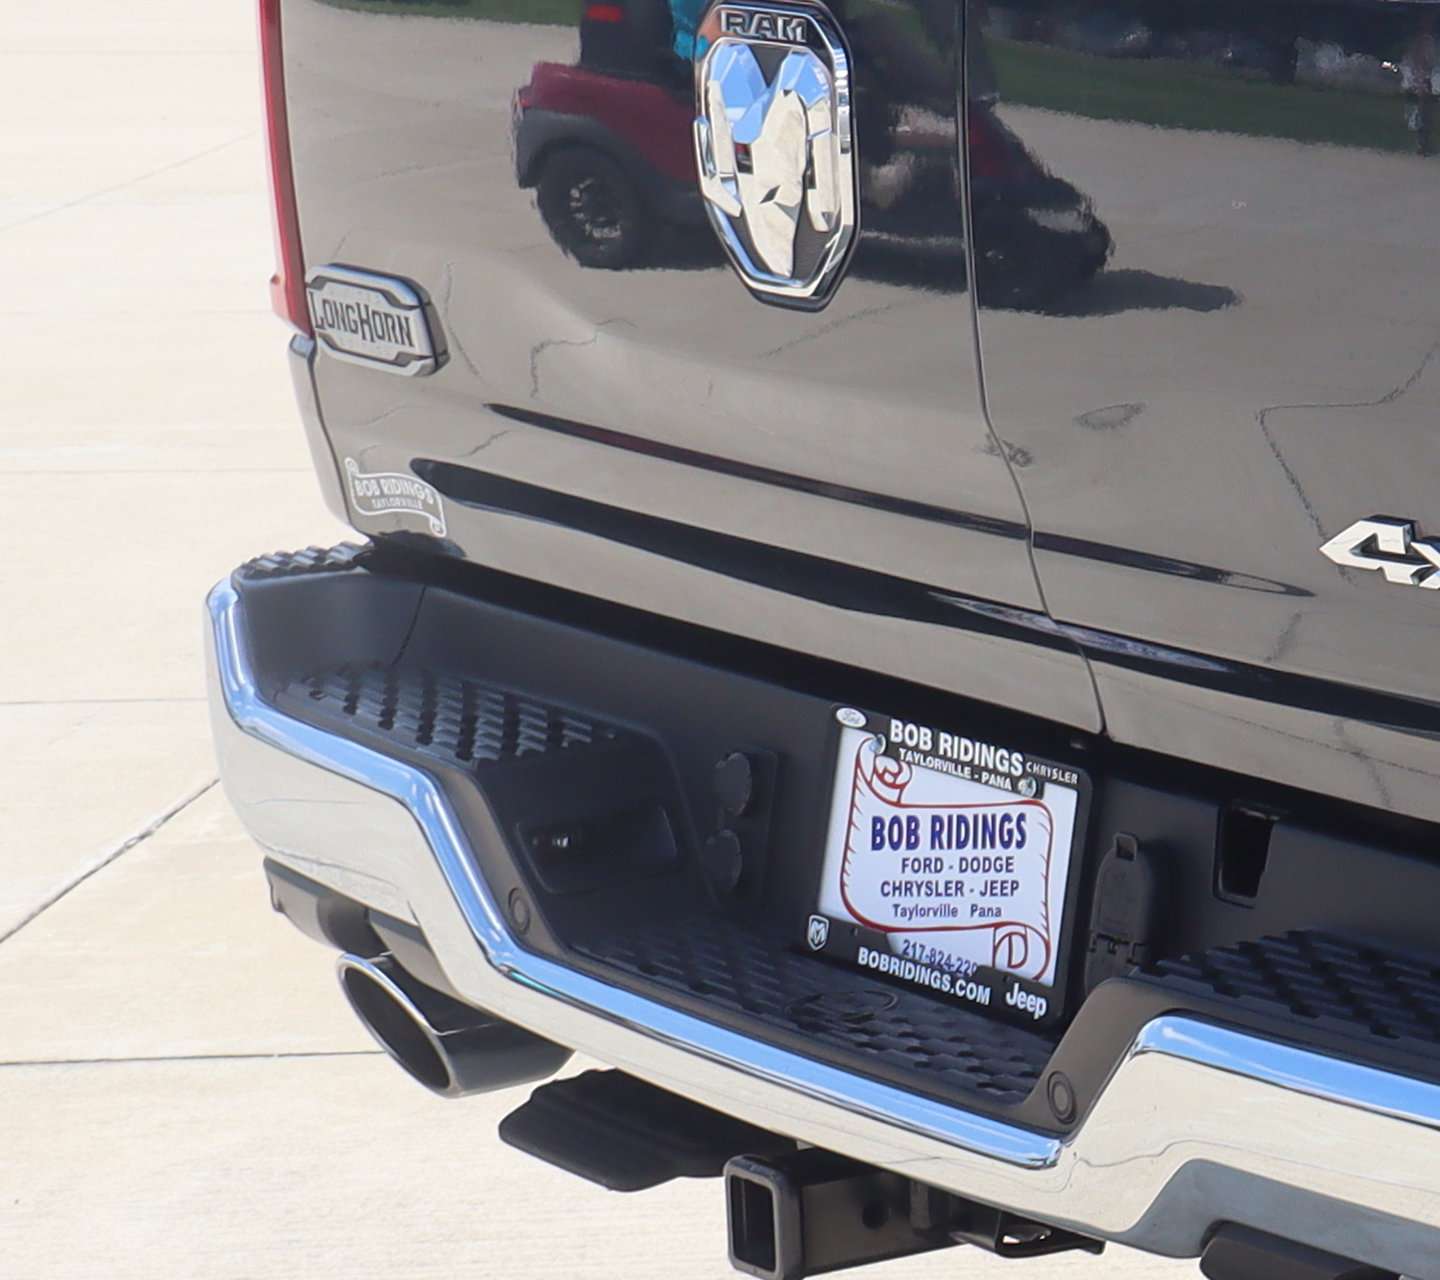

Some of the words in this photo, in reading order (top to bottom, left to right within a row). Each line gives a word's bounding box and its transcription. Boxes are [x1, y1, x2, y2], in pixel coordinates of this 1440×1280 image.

[720, 9, 808, 43] RAM
[354, 478, 381, 497] BOB
[381, 478, 434, 505] RIDINGS
[890, 718, 933, 752] BOB
[939, 731, 1024, 777] RIDINGS
[1025, 760, 1079, 785] CHRYSLER
[899, 747, 972, 780] TAYLORVILLE
[982, 773, 1012, 792] PANA
[871, 813, 920, 851] BOB
[929, 812, 1027, 851] RIDINGS
[901, 856, 944, 874] FORD
[958, 855, 1015, 874] DODGE
[880, 880, 965, 898] CHRYSLER
[979, 879, 1020, 897] JEEP
[892, 903, 959, 921] Taylorville
[970, 903, 1002, 918] Pana
[857, 946, 991, 1006] BOBRIDINGS.COM
[1005, 982, 1047, 1020] Jeep
